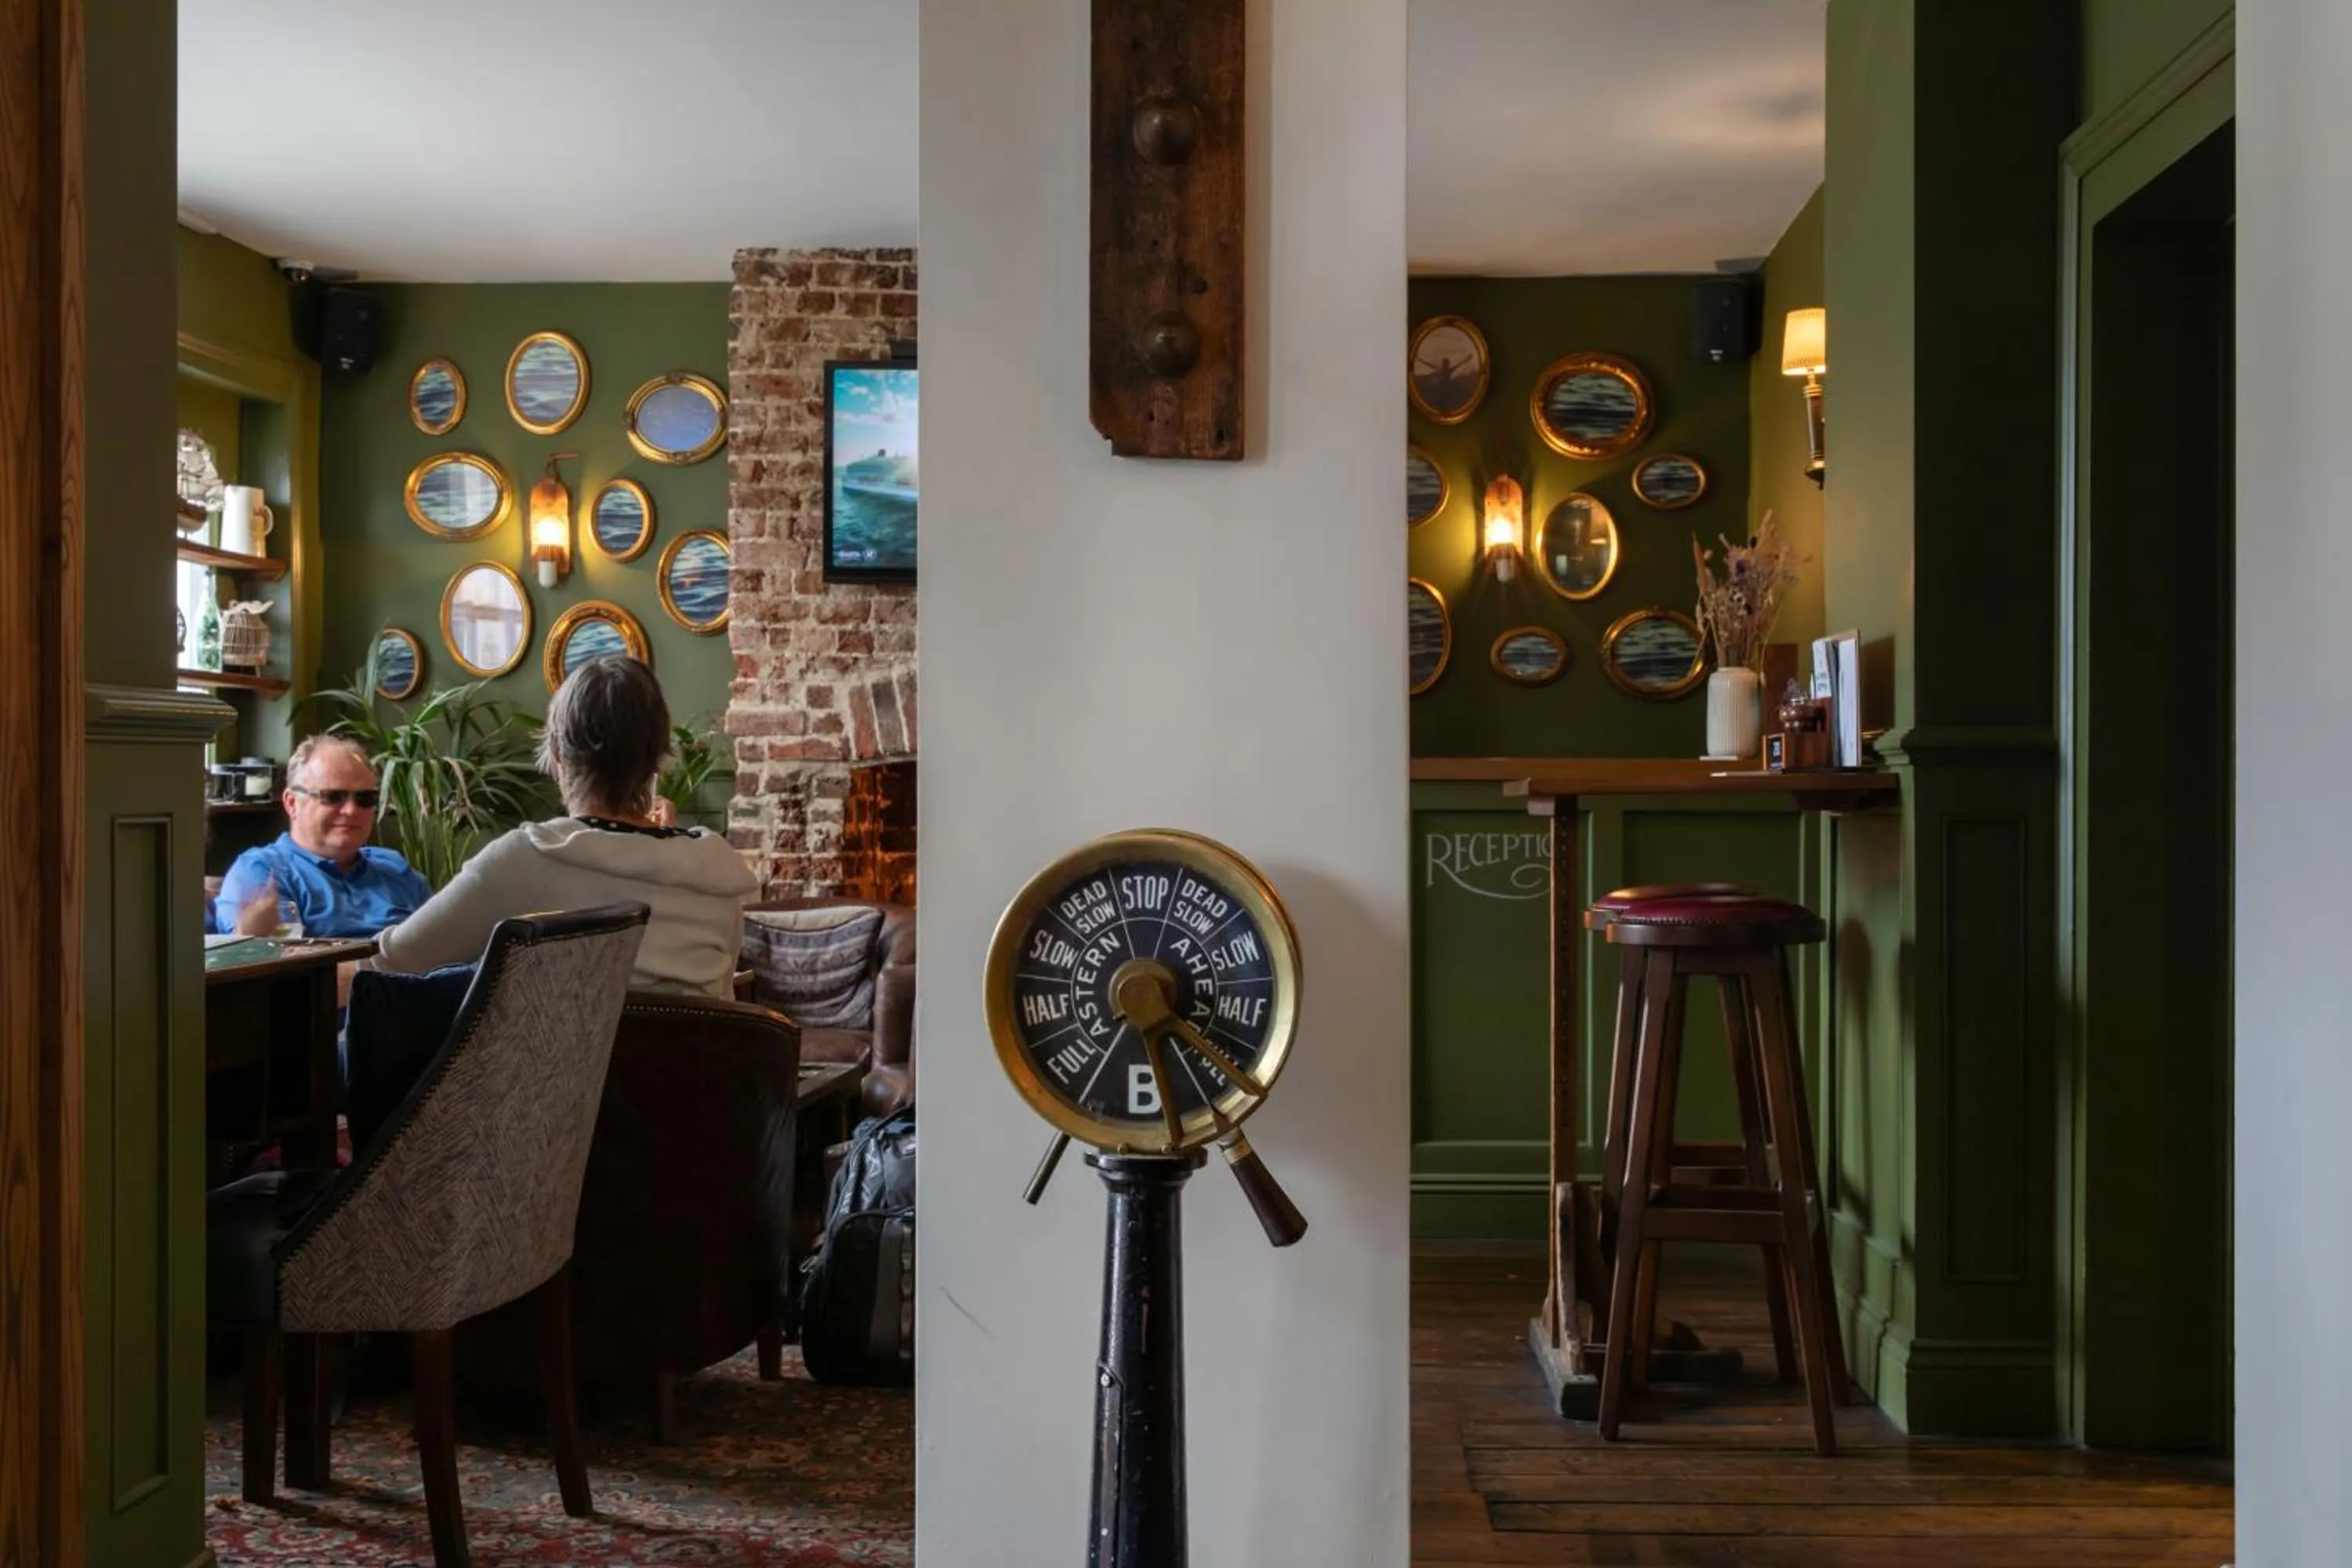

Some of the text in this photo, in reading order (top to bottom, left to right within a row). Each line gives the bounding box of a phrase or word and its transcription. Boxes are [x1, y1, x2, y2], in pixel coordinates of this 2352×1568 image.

[1061, 880, 1107, 920] DEAD
[1122, 876, 1168, 910] STOP
[1181, 878, 1228, 918] DEAD
[1076, 900, 1116, 935] SLOW
[1174, 901, 1214, 935] SLOW
[1029, 929, 1080, 970] SLOW
[1211, 931, 1261, 971] SLOW
[1075, 932, 1121, 1036] ASTERN
[1022, 993, 1069, 1026] HALF
[1218, 996, 1267, 1028] HALF
[1047, 1040, 1097, 1085] FULL
[1127, 1063, 1162, 1113] B
